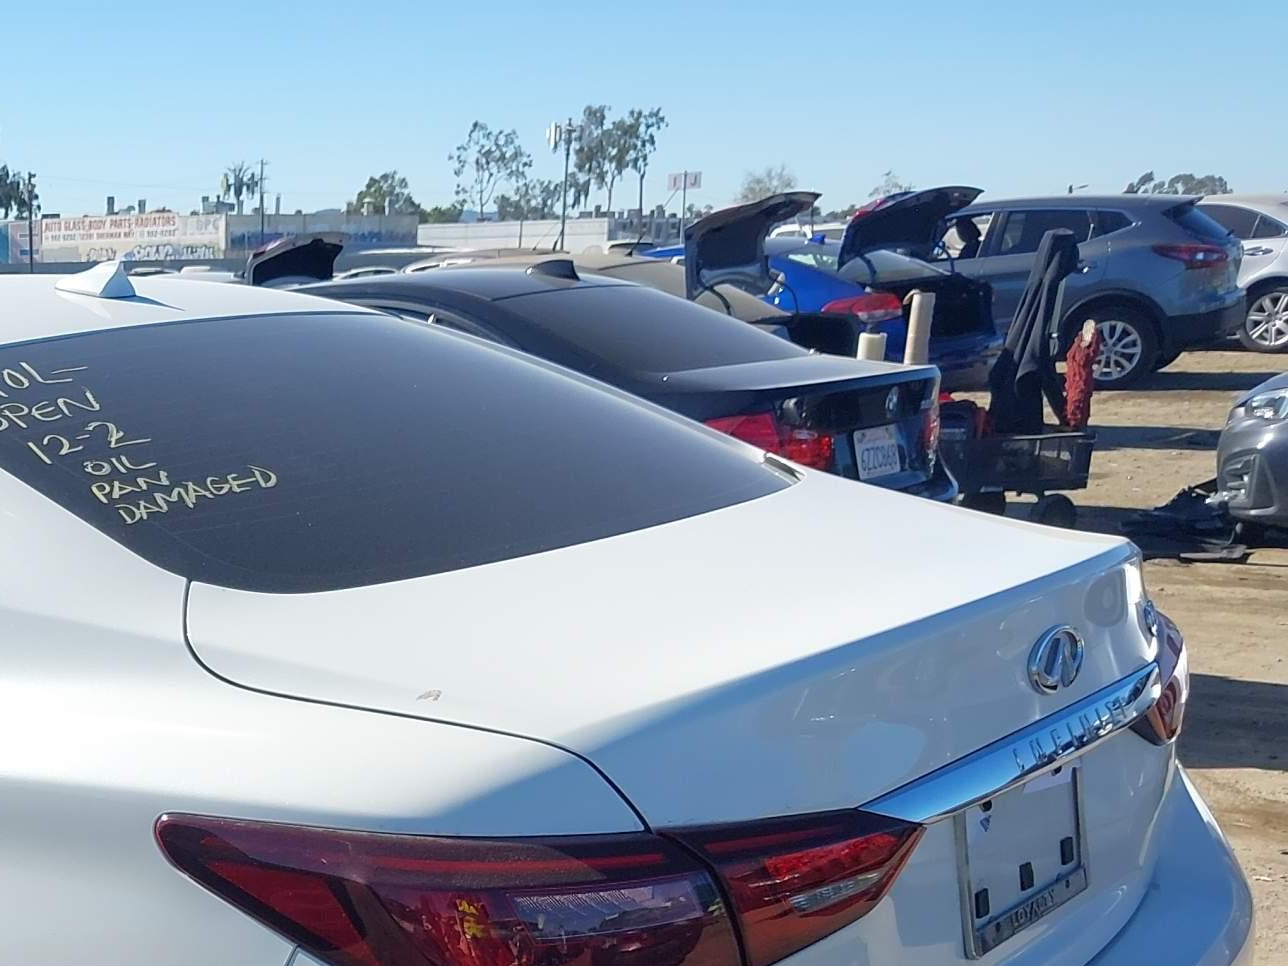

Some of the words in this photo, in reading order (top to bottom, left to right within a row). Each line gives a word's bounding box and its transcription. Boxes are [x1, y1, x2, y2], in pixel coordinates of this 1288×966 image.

[27, 421, 152, 464] 12-2
[83, 455, 156, 476] OIL
[91, 470, 171, 504] PAN
[114, 465, 278, 525] DAMAGED
